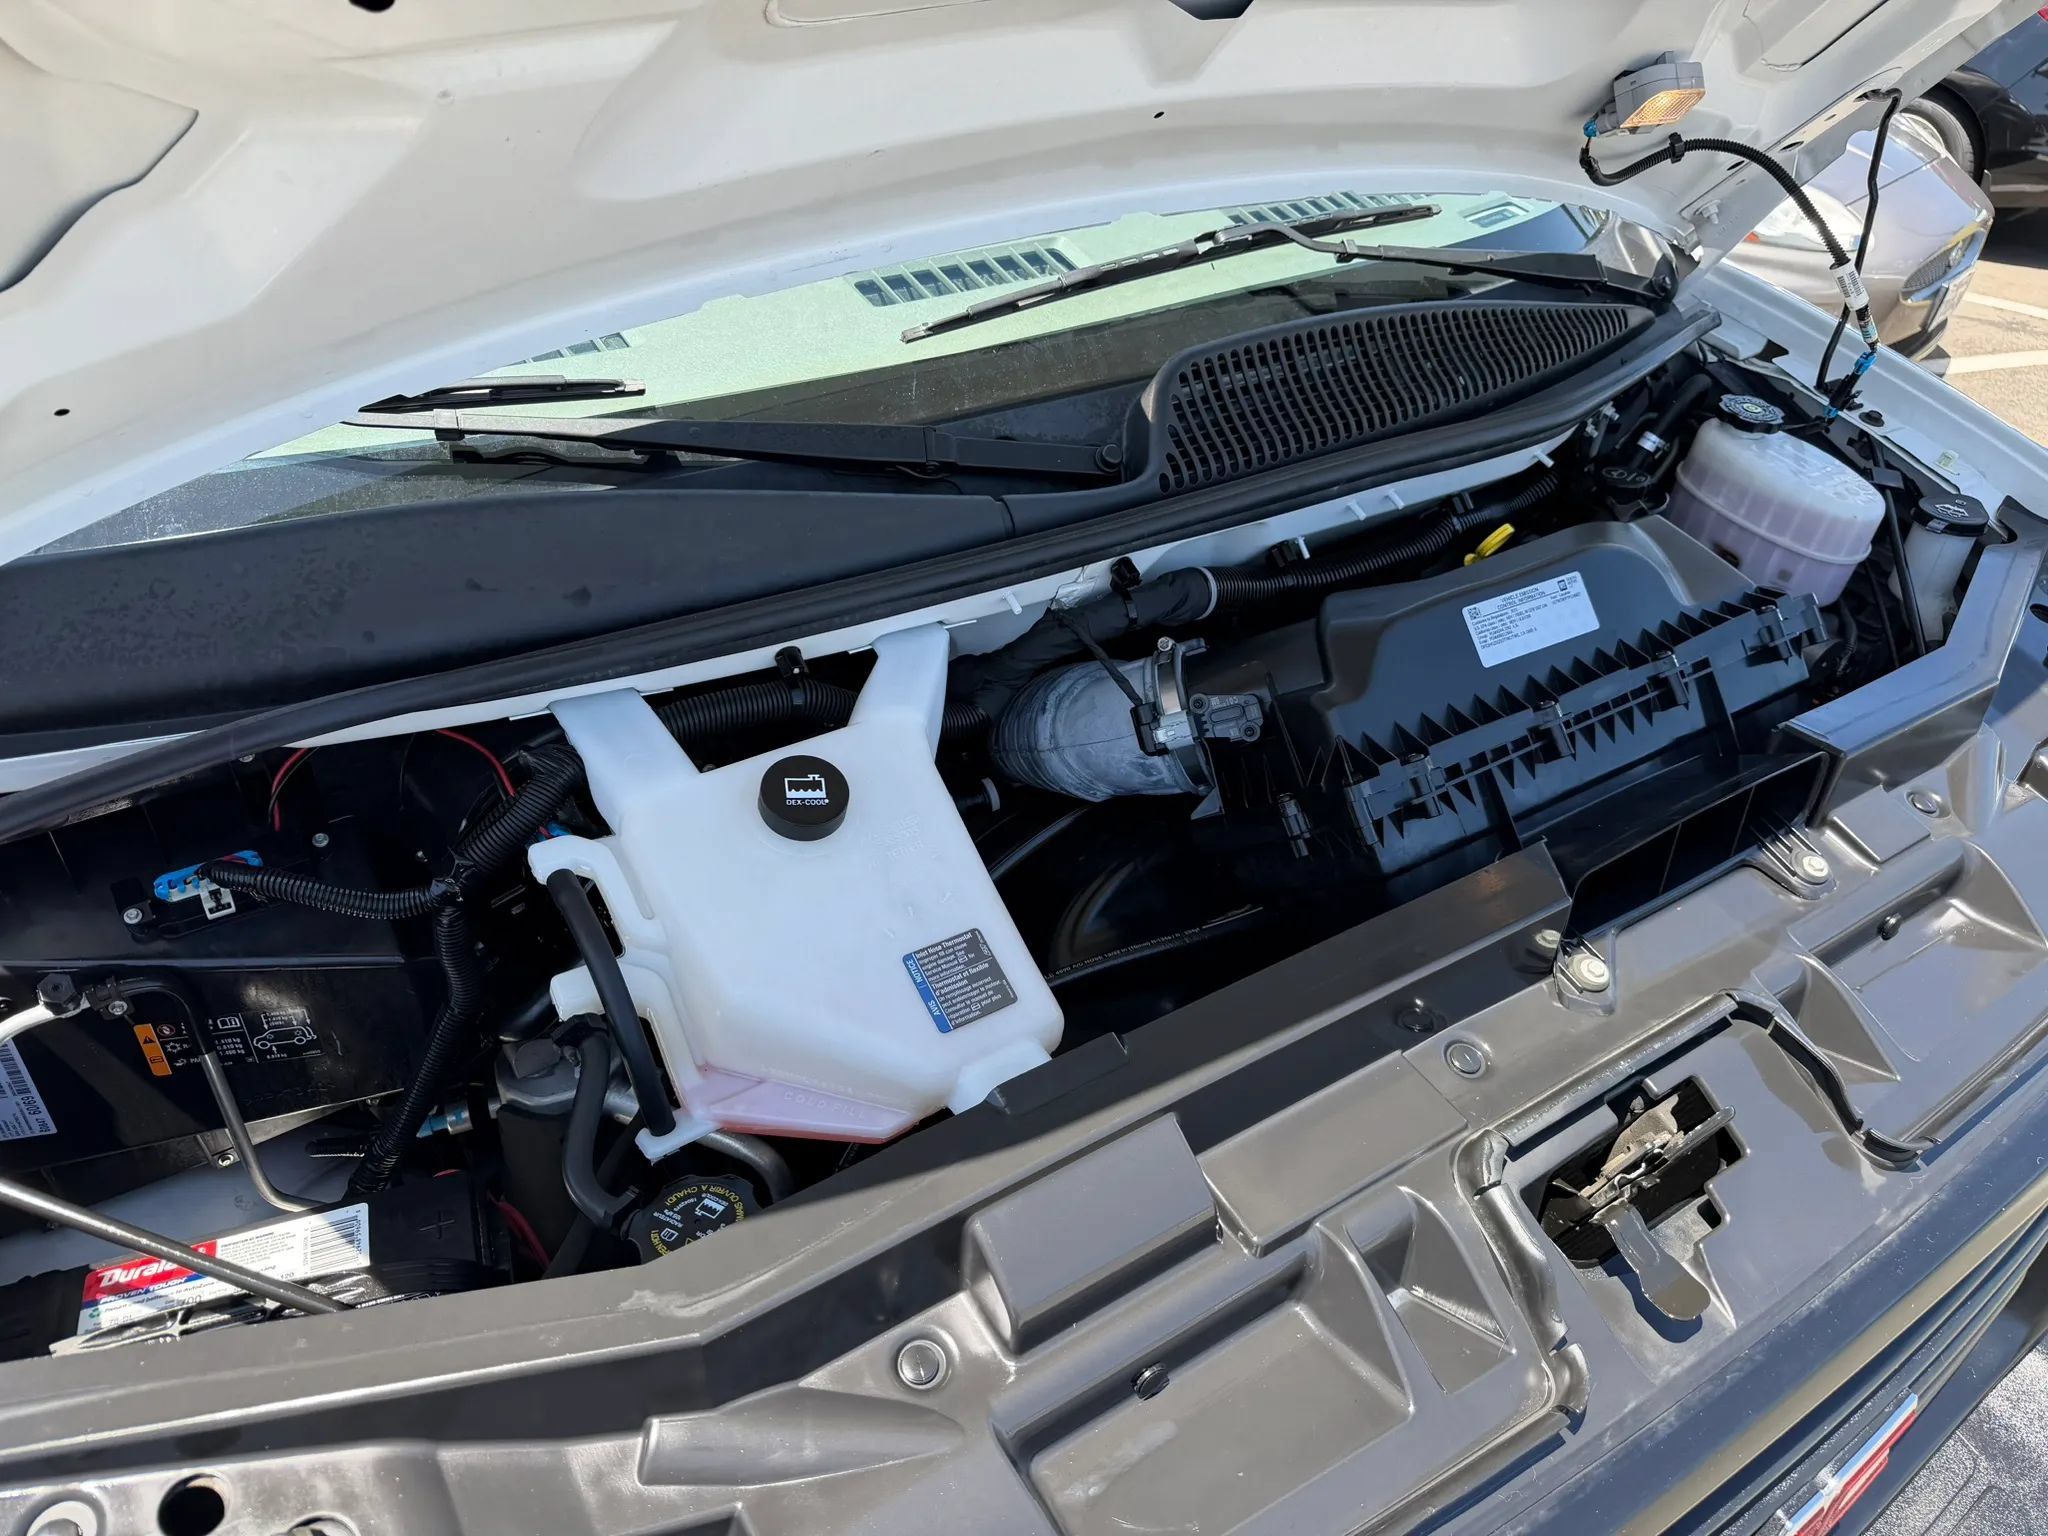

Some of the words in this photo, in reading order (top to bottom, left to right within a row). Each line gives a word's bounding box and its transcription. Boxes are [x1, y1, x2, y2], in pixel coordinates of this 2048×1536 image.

[927, 944, 942, 954] Hose
[941, 932, 973, 948] Thermostat
[906, 959, 923, 982] NOTICE
[931, 972, 963, 989] Thermostat
[927, 999, 940, 1016] AVIS
[98, 1287, 147, 1303] PROVEN
[148, 1276, 188, 1292] TOUGH
